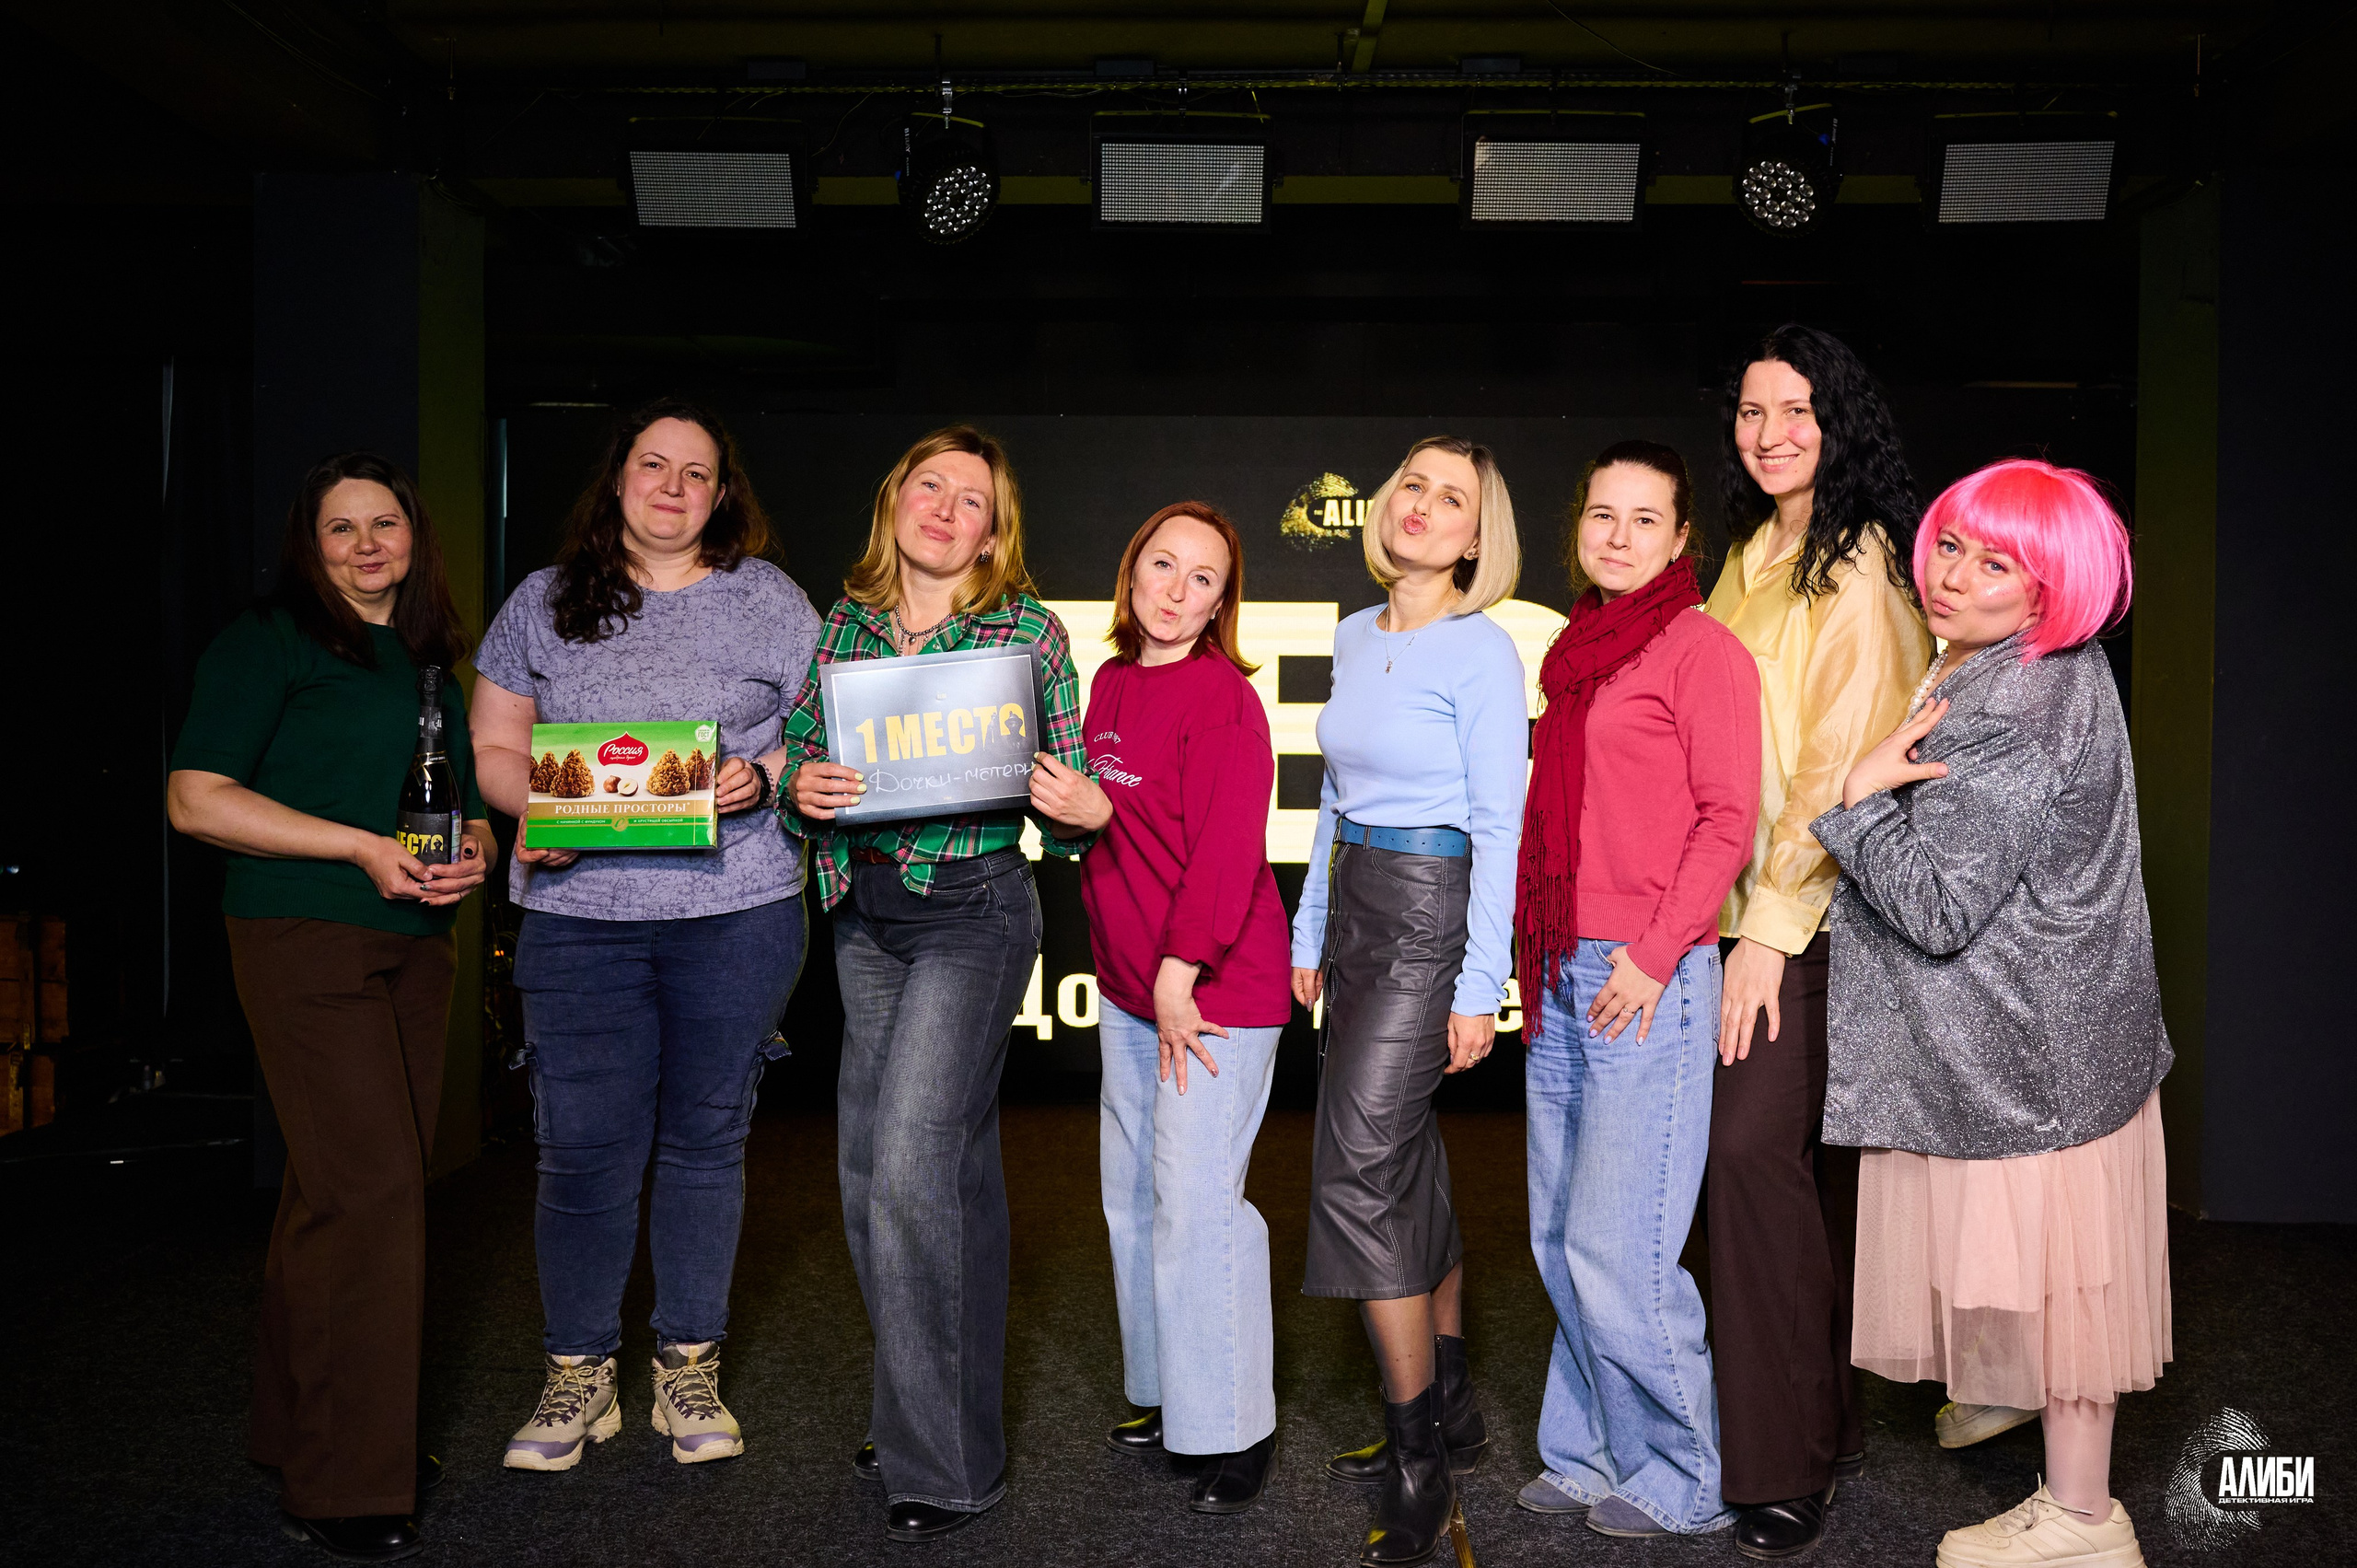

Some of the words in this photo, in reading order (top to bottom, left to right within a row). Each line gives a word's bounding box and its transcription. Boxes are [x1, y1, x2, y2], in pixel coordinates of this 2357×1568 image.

[855, 718, 877, 763] 1
[885, 703, 1026, 761] МЕСТО
[1094, 731, 1114, 742] CLUB
[603, 743, 644, 757] Россия
[1093, 753, 1143, 787] France
[554, 804, 610, 815] РОДНЫЕ
[613, 802, 687, 813] ПРОСТОРЫ
